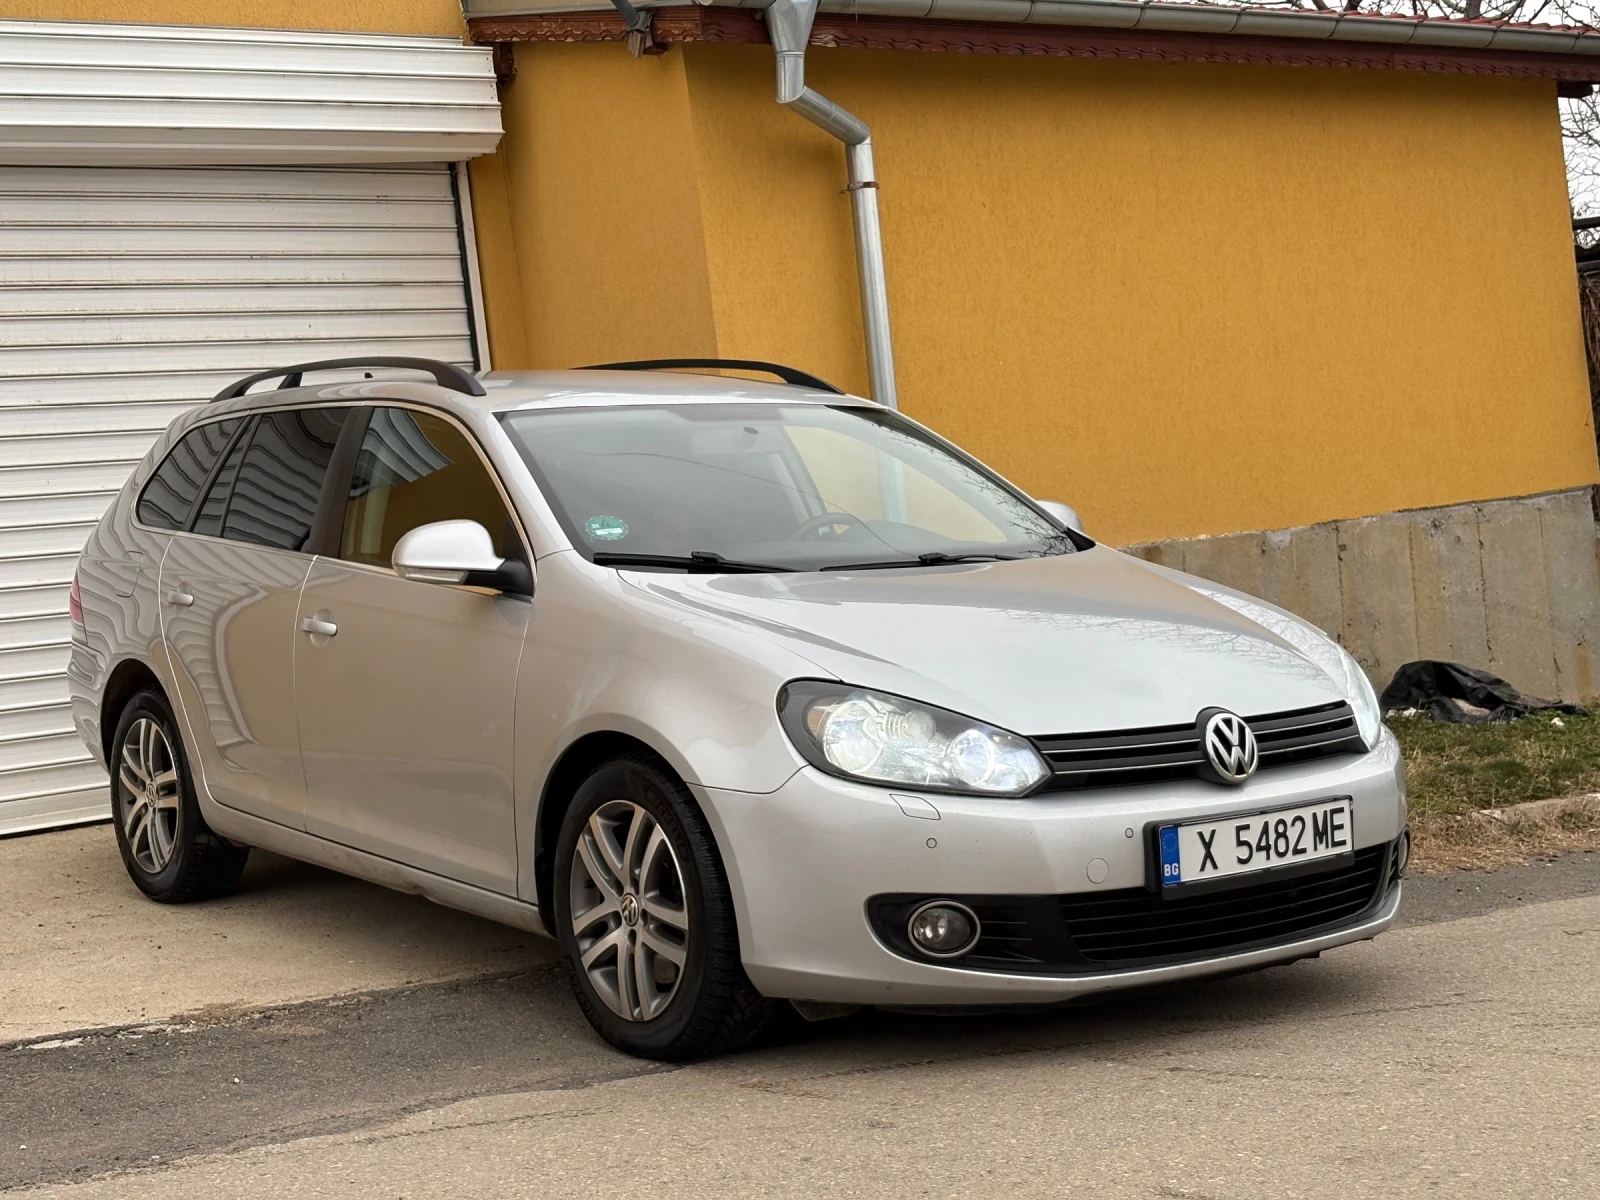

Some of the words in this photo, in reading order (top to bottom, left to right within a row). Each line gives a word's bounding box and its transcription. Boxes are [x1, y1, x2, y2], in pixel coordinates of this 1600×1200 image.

[1206, 713, 1257, 782] VW
[1163, 863, 1179, 877] BG
[1196, 828, 1219, 872] X
[1235, 814, 1307, 865] 5482
[1312, 806, 1347, 852] ME
